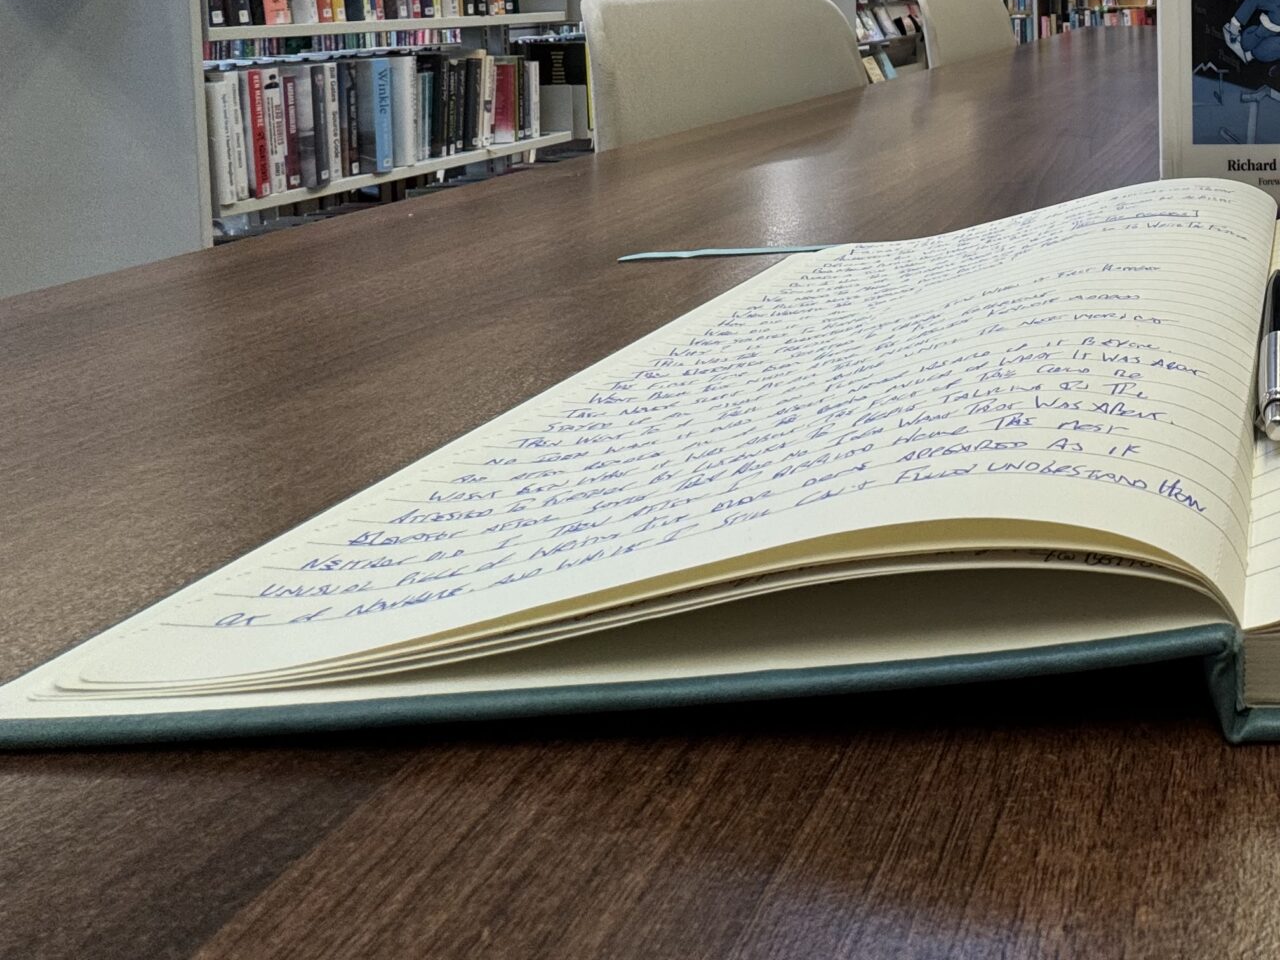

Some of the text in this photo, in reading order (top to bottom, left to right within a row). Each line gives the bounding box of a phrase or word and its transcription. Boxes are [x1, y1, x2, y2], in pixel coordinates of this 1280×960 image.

[378, 68, 389, 115] Winkle
[331, 111, 339, 138] Source
[1227, 159, 1277, 172] Richard
